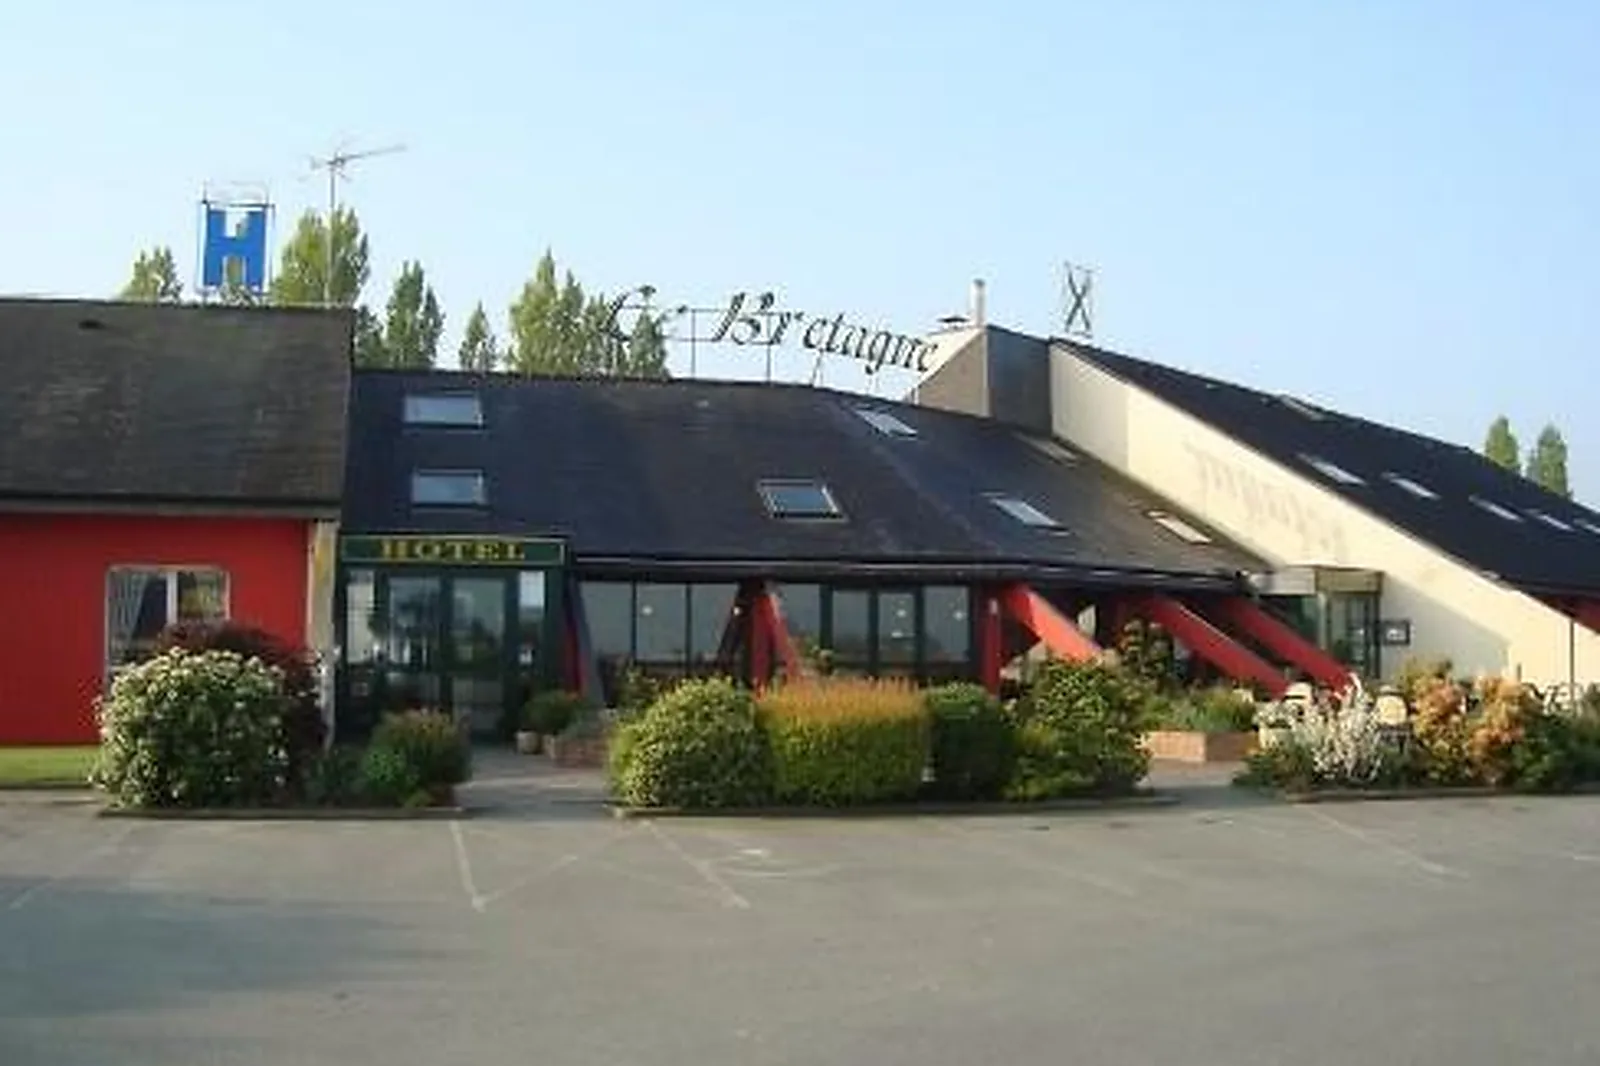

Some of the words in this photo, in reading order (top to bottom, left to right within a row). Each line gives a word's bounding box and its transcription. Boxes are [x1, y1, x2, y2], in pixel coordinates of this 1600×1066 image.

[204, 209, 266, 287] H
[711, 291, 938, 374] Bretagne
[380, 541, 525, 562] HOTEL
